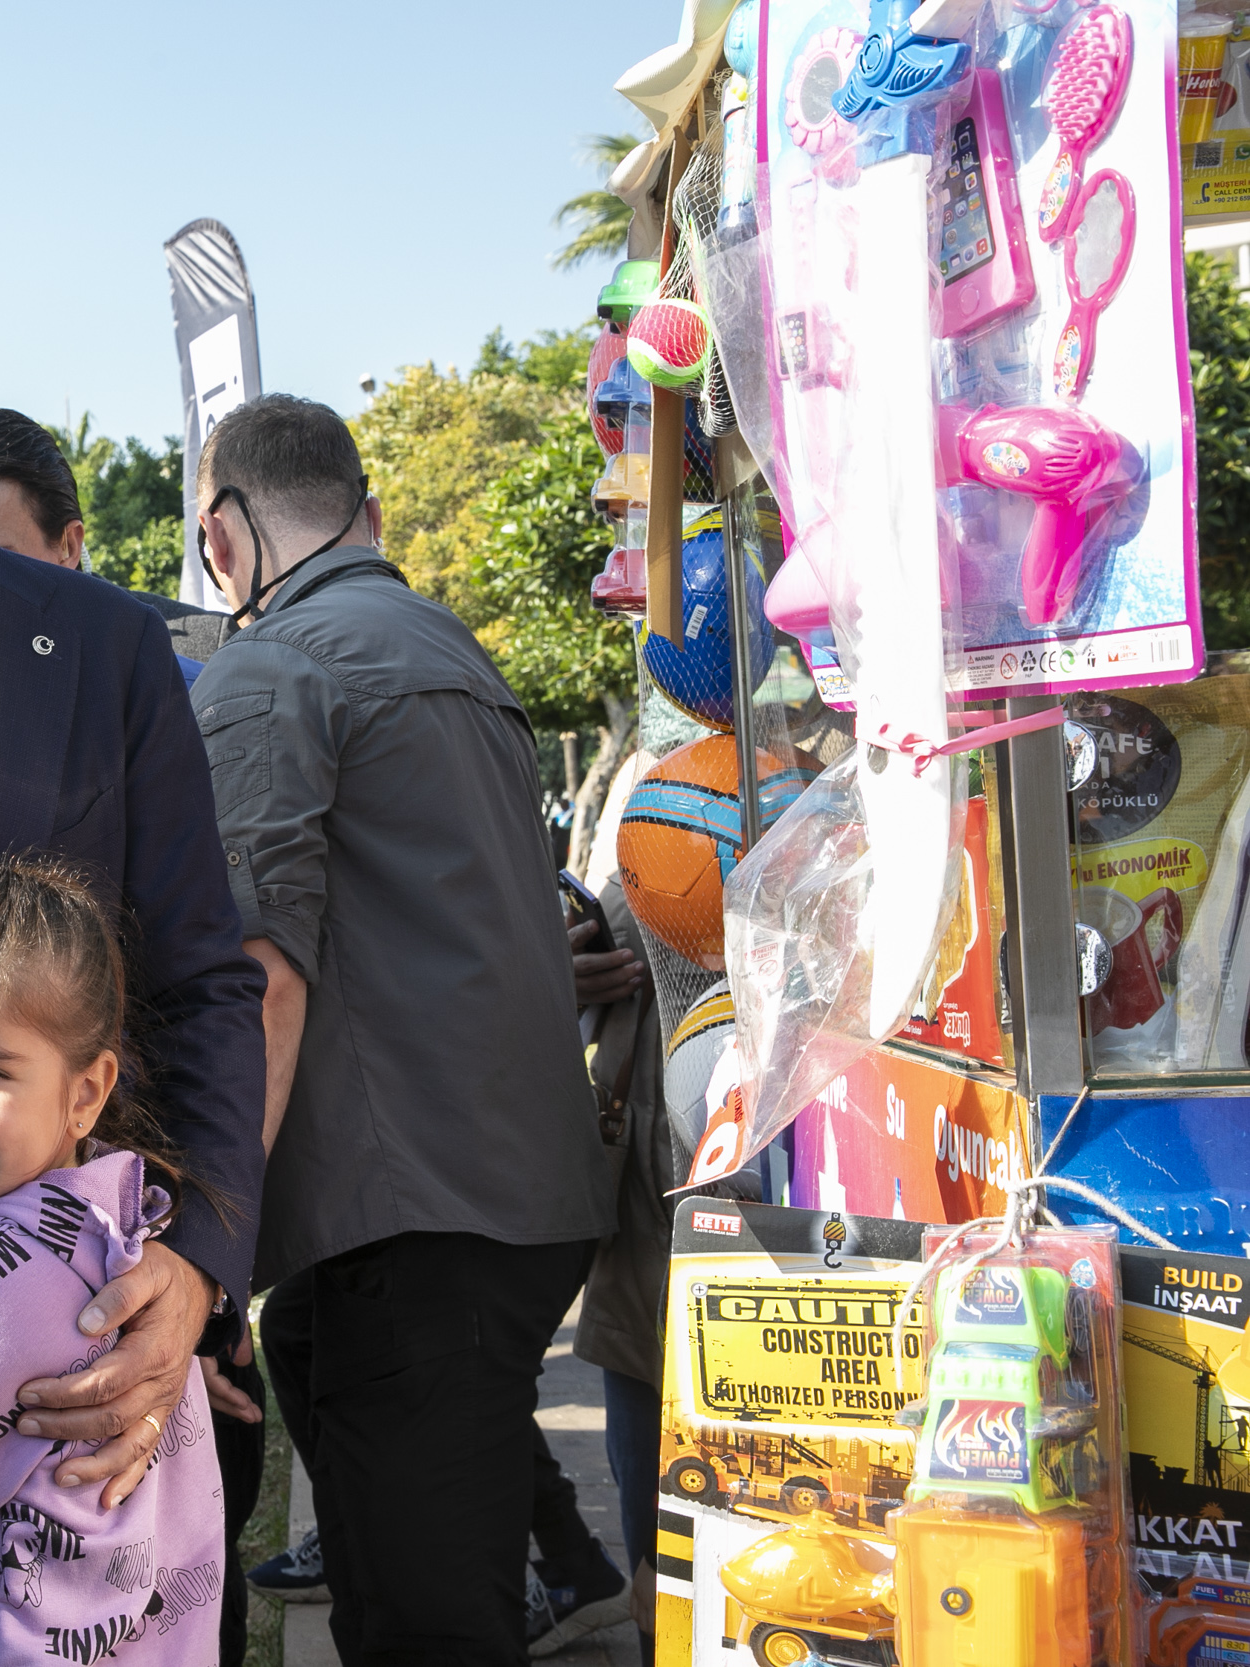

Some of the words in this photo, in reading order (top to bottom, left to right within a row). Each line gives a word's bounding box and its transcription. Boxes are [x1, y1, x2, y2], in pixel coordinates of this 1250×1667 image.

[1213, 179, 1247, 188] MÜŞTERİ
[1077, 793, 1159, 809] KÖPÜKLÜ
[1097, 847, 1192, 881] EKONOMİK
[1157, 867, 1186, 881] PAKET
[886, 1083, 905, 1141] Su
[933, 1104, 1025, 1193] Oyuncak
[693, 1213, 741, 1232] KETTE
[1163, 1266, 1243, 1293] BUILD
[1153, 1285, 1243, 1315] İNŞAAT
[762, 1327, 923, 1359] CONSTRUCTIO
[821, 1357, 881, 1386] AREA
[713, 1382, 825, 1408] AUTHORIZED
[832, 1388, 923, 1411] PERSONN
[958, 1449, 1021, 1469] POWER
[1137, 1514, 1243, 1548] KKAT
[1195, 1585, 1217, 1595] FUEL
